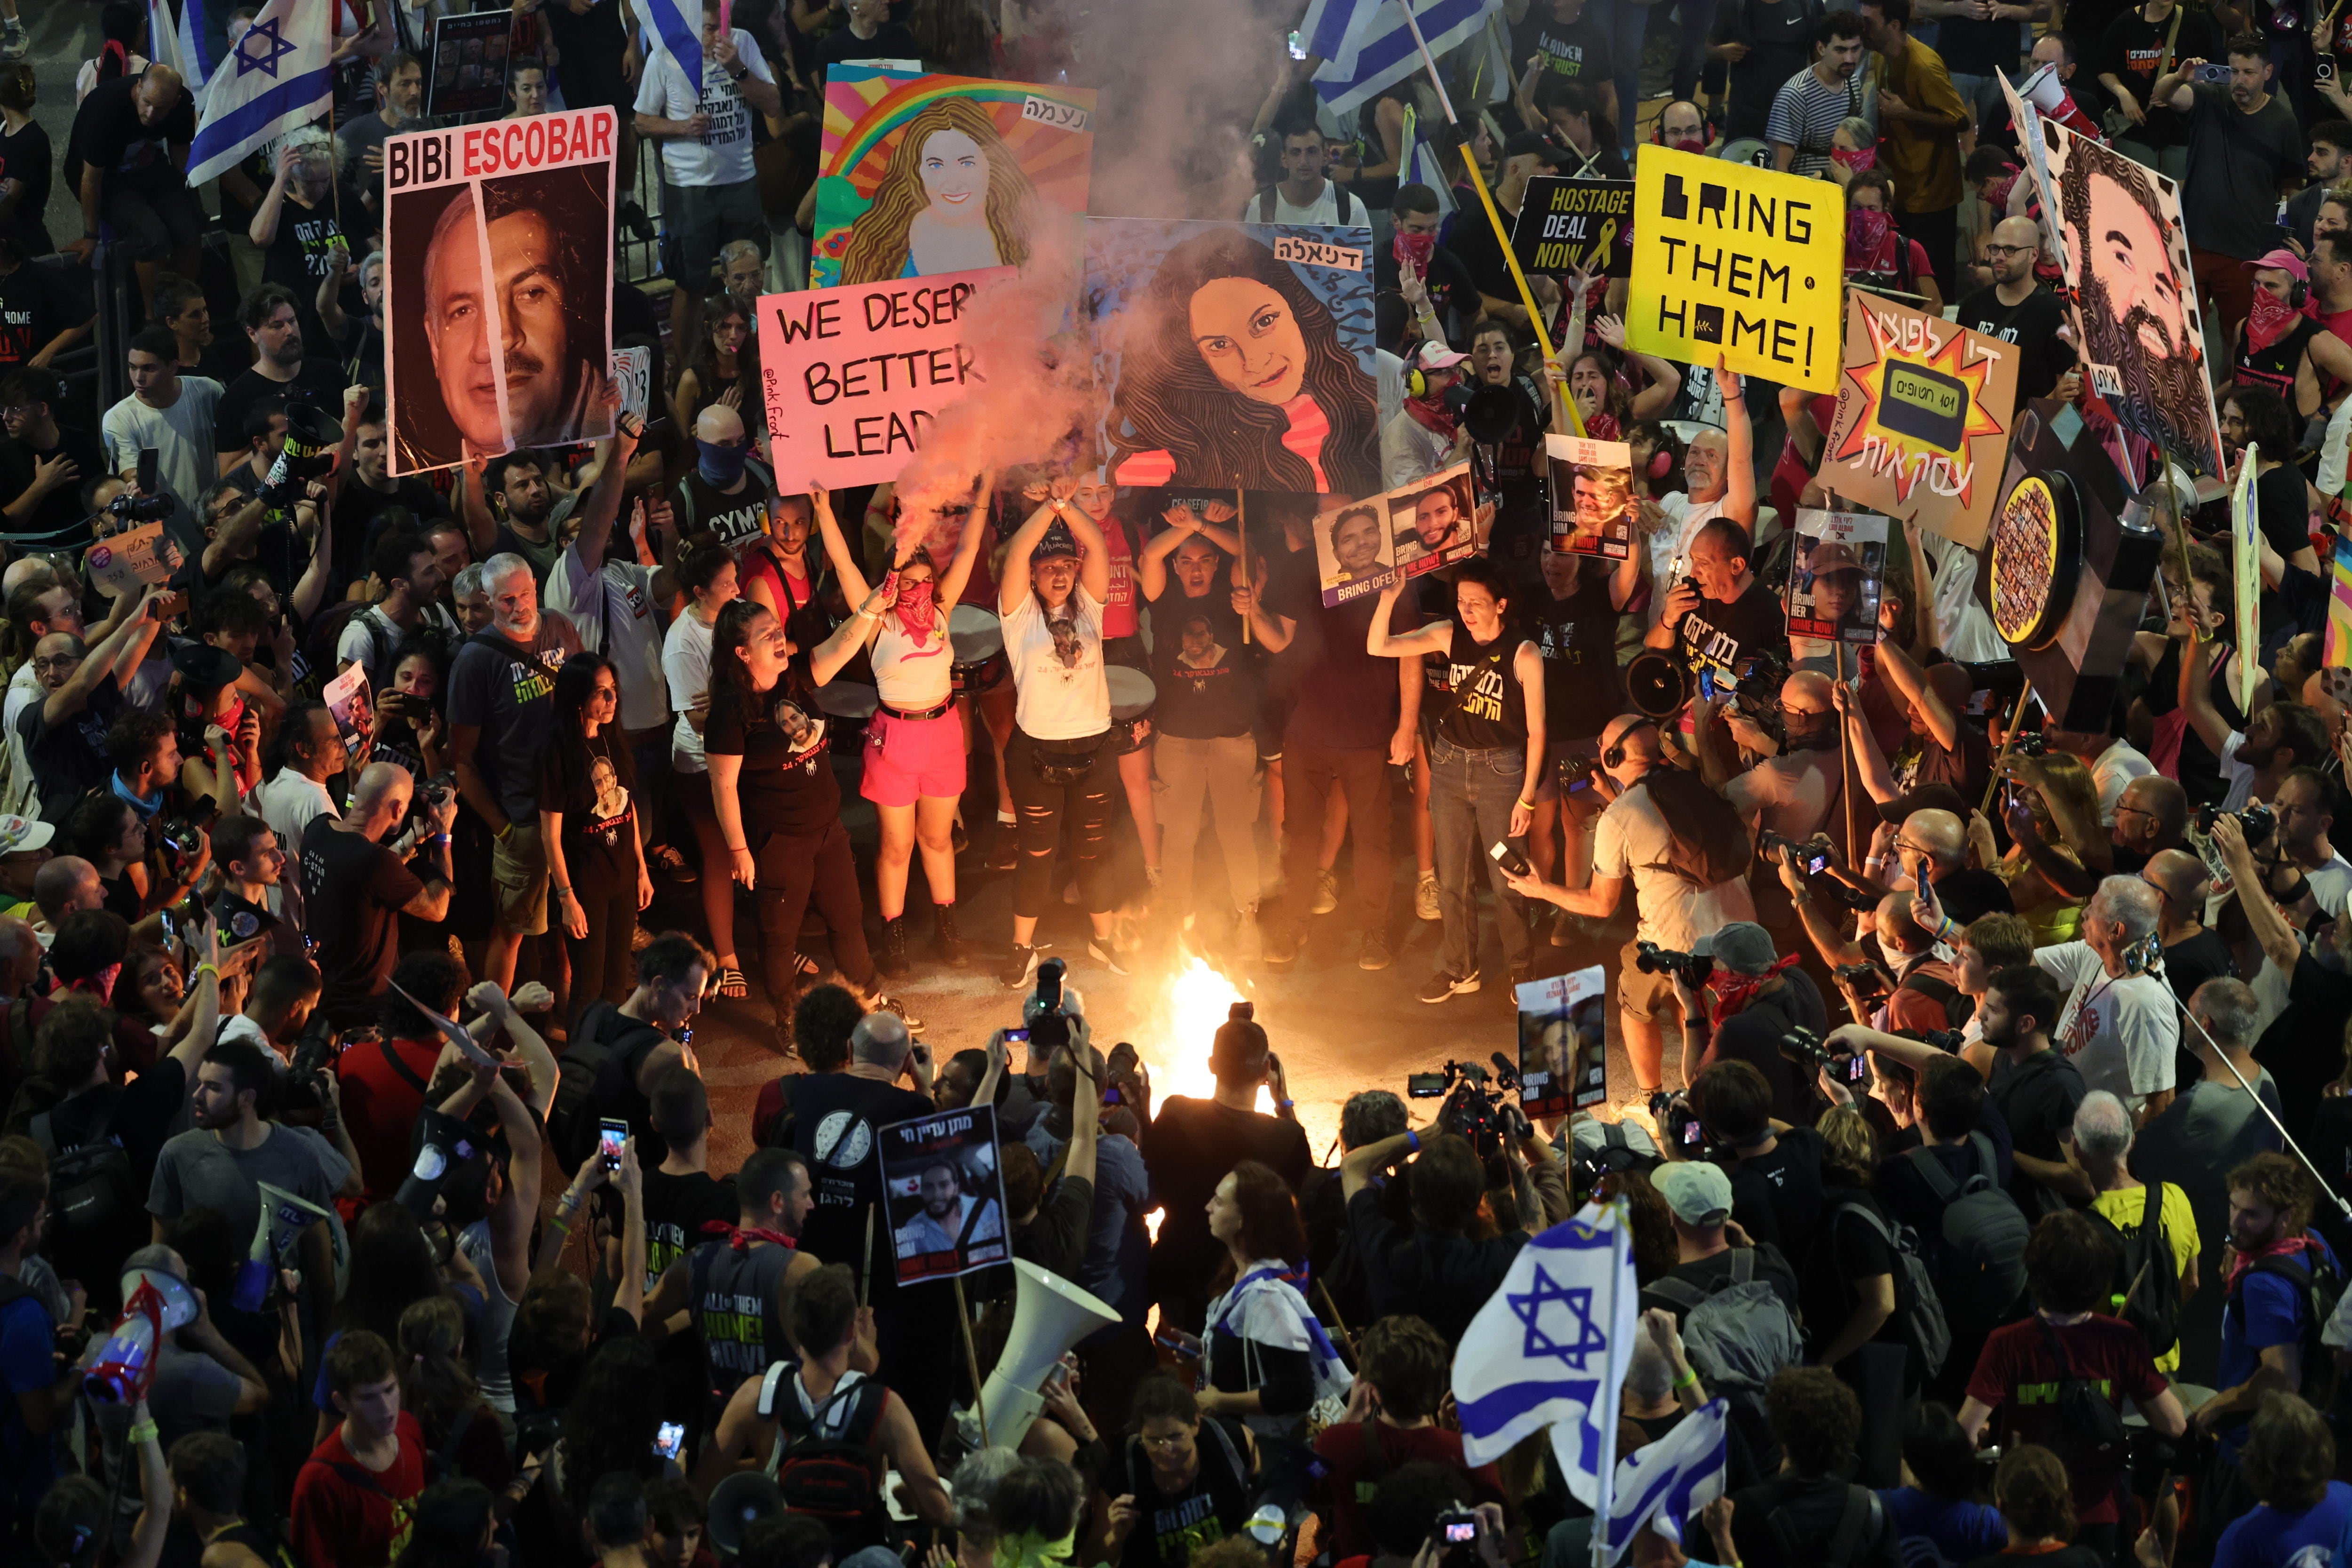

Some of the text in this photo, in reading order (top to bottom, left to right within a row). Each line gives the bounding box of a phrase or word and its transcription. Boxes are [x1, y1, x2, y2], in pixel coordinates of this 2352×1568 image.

[734, 111, 745, 125] על
[1026, 100, 1084, 128] נעמה
[736, 126, 747, 141] של
[389, 112, 612, 189] BIBI ESCOBAR
[1550, 187, 1632, 214] HOSTAGE
[1661, 173, 1812, 245] BRING
[1542, 215, 1587, 239] DEAL
[1279, 239, 1359, 267] דניאלה
[1534, 242, 1583, 269] NOW
[1660, 235, 1789, 303] THEM
[5, 311, 32, 325] HOME
[776, 282, 977, 345] WE DESER
[1658, 294, 1814, 377] HOME!
[1867, 311, 2002, 385] די לפוצץ
[803, 343, 987, 406] BETTER
[2091, 367, 2120, 397] איתן
[1896, 380, 1956, 412] 101 חטופים
[824, 410, 935, 459] LEAD
[1850, 433, 1975, 500] עסקאות
[1172, 498, 1209, 510] CEASEFIR
[1553, 510, 1576, 522] BRING
[1553, 522, 1568, 534] HIM
[1395, 540, 1417, 557] BRING
[1576, 536, 1598, 549] NOW!
[1397, 553, 1411, 566] HIM
[1418, 552, 1440, 569] NOW!
[1338, 582, 1370, 602] BRING
[1792, 592, 1816, 606] BRING
[1791, 605, 1806, 618] HER
[1790, 618, 1836, 635] HOME NOW!
[344, 732, 360, 747] BRING
[782, 761, 793, 771] 24
[582, 826, 594, 834] 24
[1523, 1071, 1549, 1087] BRING
[1523, 1086, 1539, 1101] HIM
[899, 1115, 973, 1144] מתן עדיין חי
[703, 1293, 725, 1312] ALL
[732, 1294, 763, 1316] THEM
[703, 1311, 763, 1345] HOME!
[708, 1340, 767, 1375] NOW!
